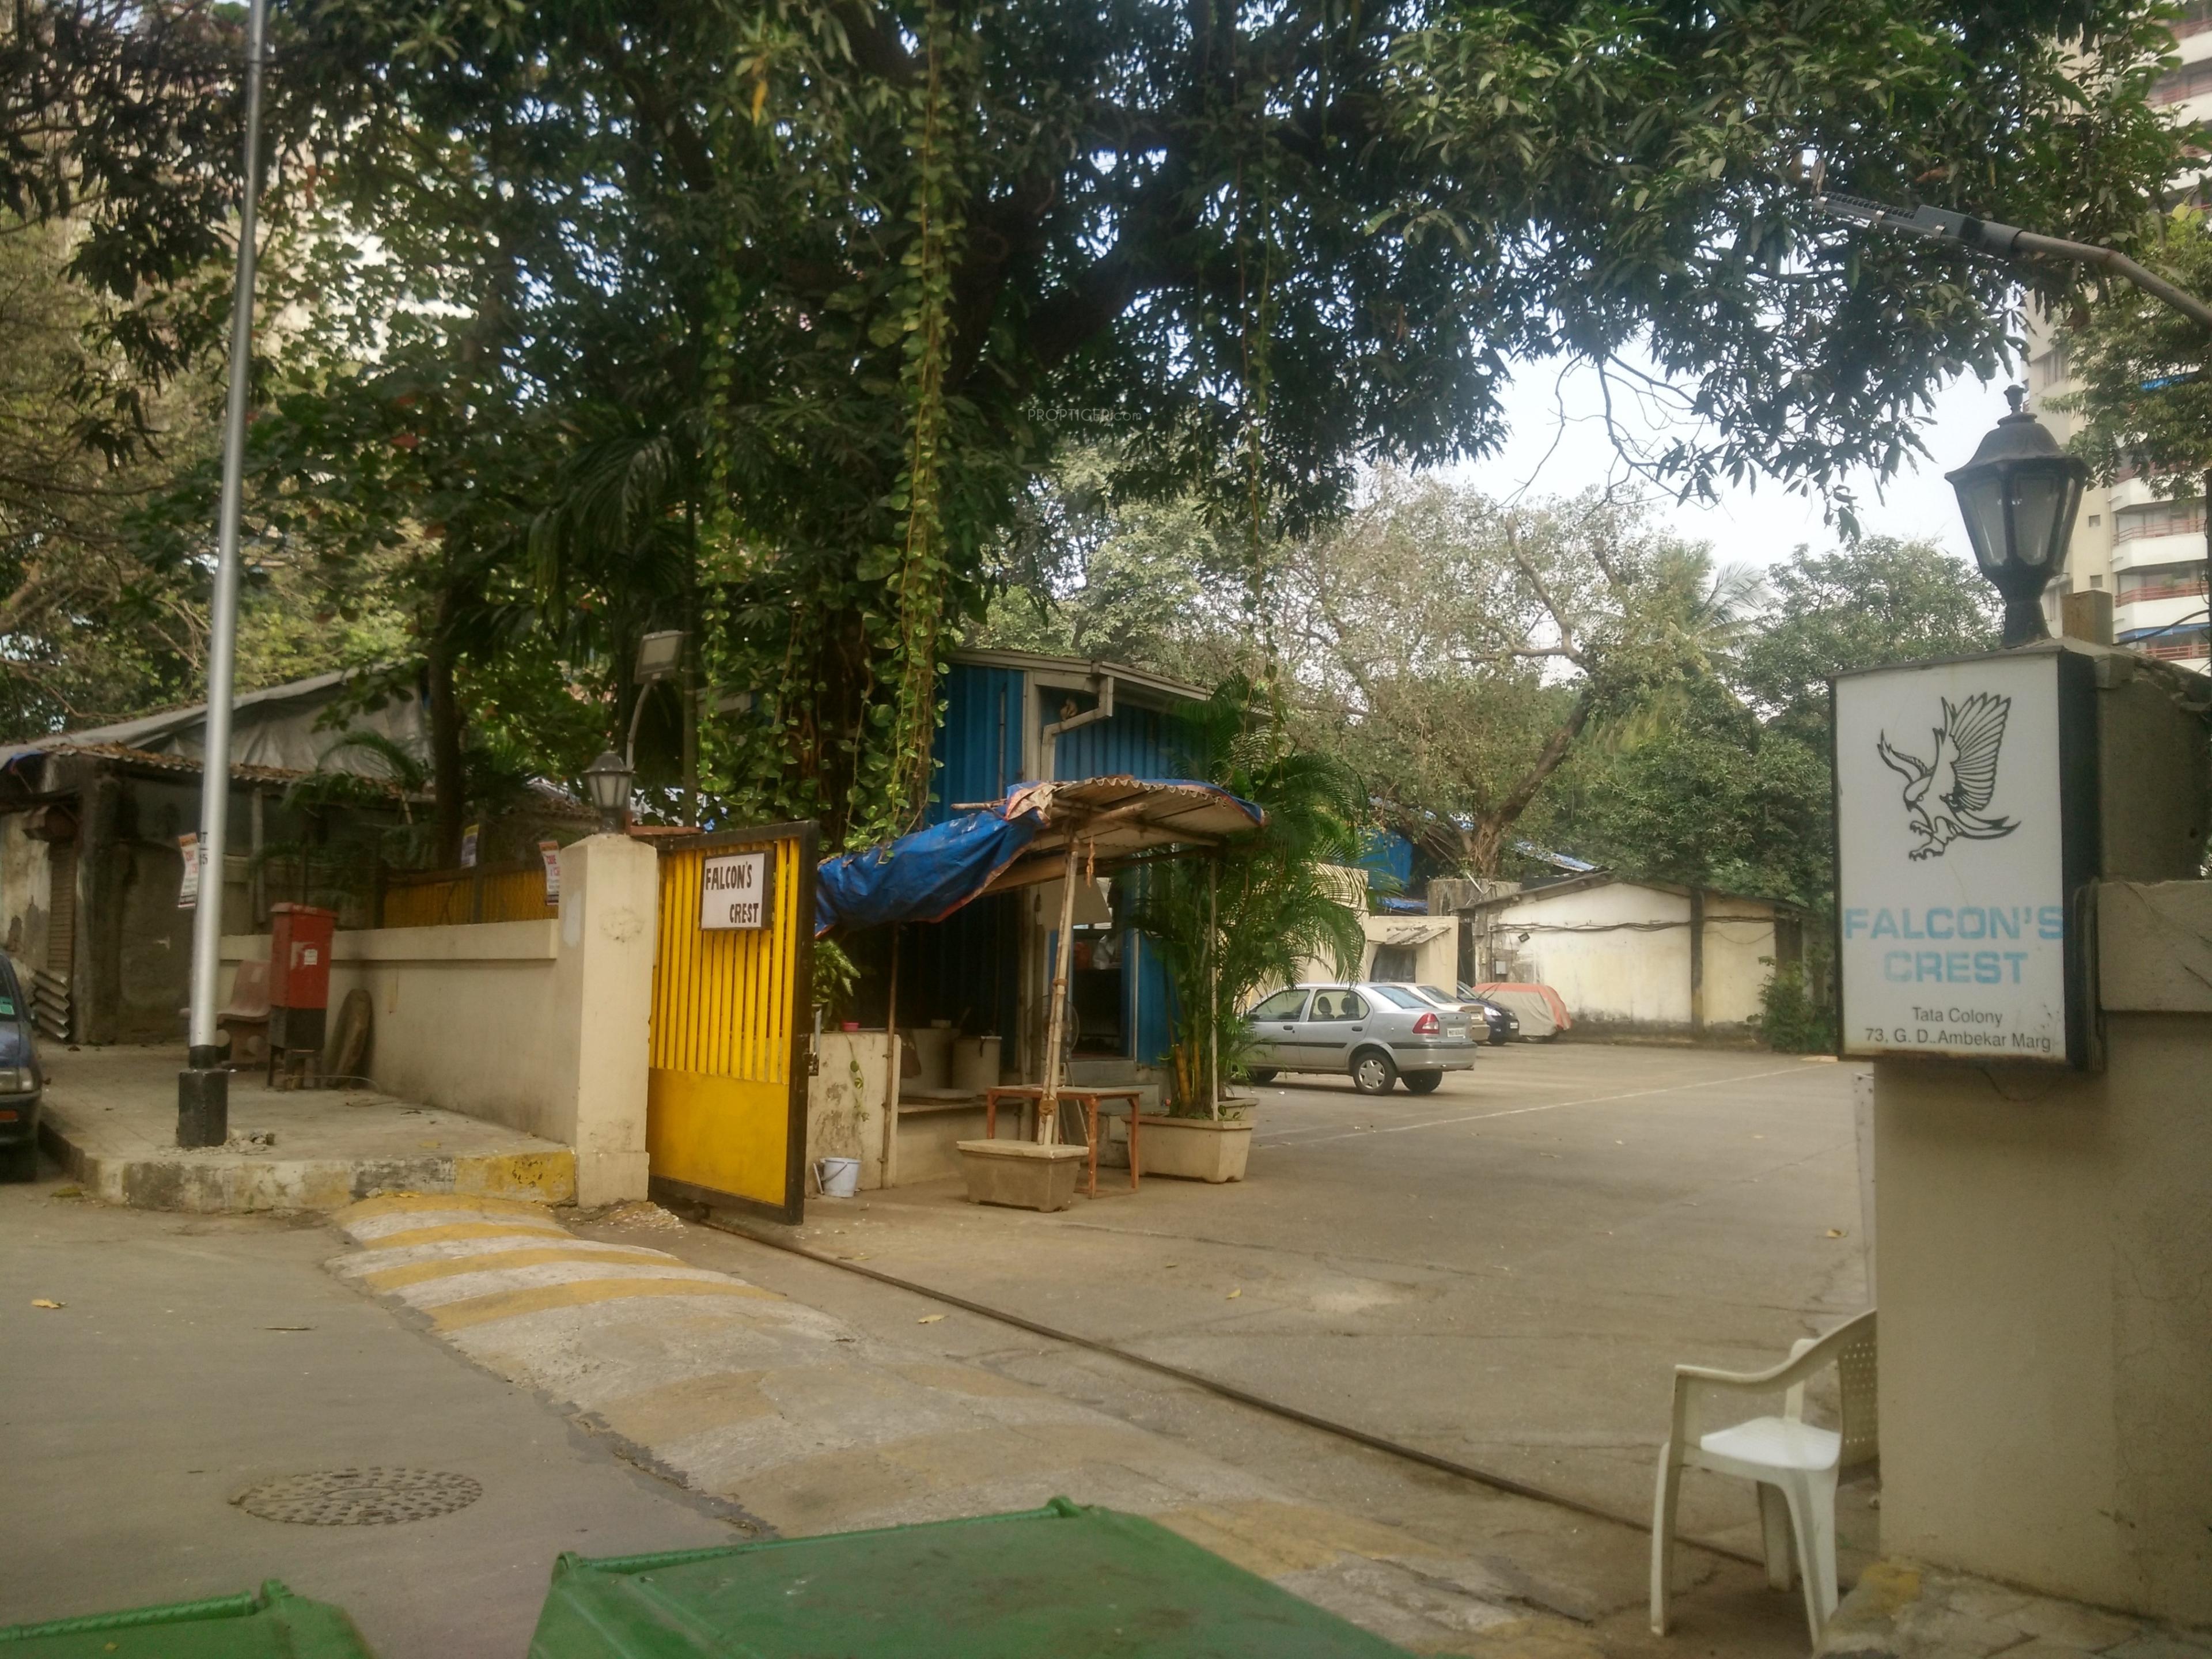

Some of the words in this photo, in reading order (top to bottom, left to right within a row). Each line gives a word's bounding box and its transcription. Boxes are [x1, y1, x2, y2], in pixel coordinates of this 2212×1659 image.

[705, 861, 752, 890] FALCON'S
[729, 903, 759, 923] CREST
[1844, 906, 2063, 940] FALCON'S
[1883, 950, 2028, 984] CREST
[1912, 1007, 1944, 1022] Tata
[1949, 1008, 2003, 1028] Colony
[1865, 1028, 1888, 1043] 73,
[1893, 1028, 1911, 1043] G.
[1937, 1029, 2006, 1047] Ambekar
[2012, 1032, 2051, 1053] Marg
